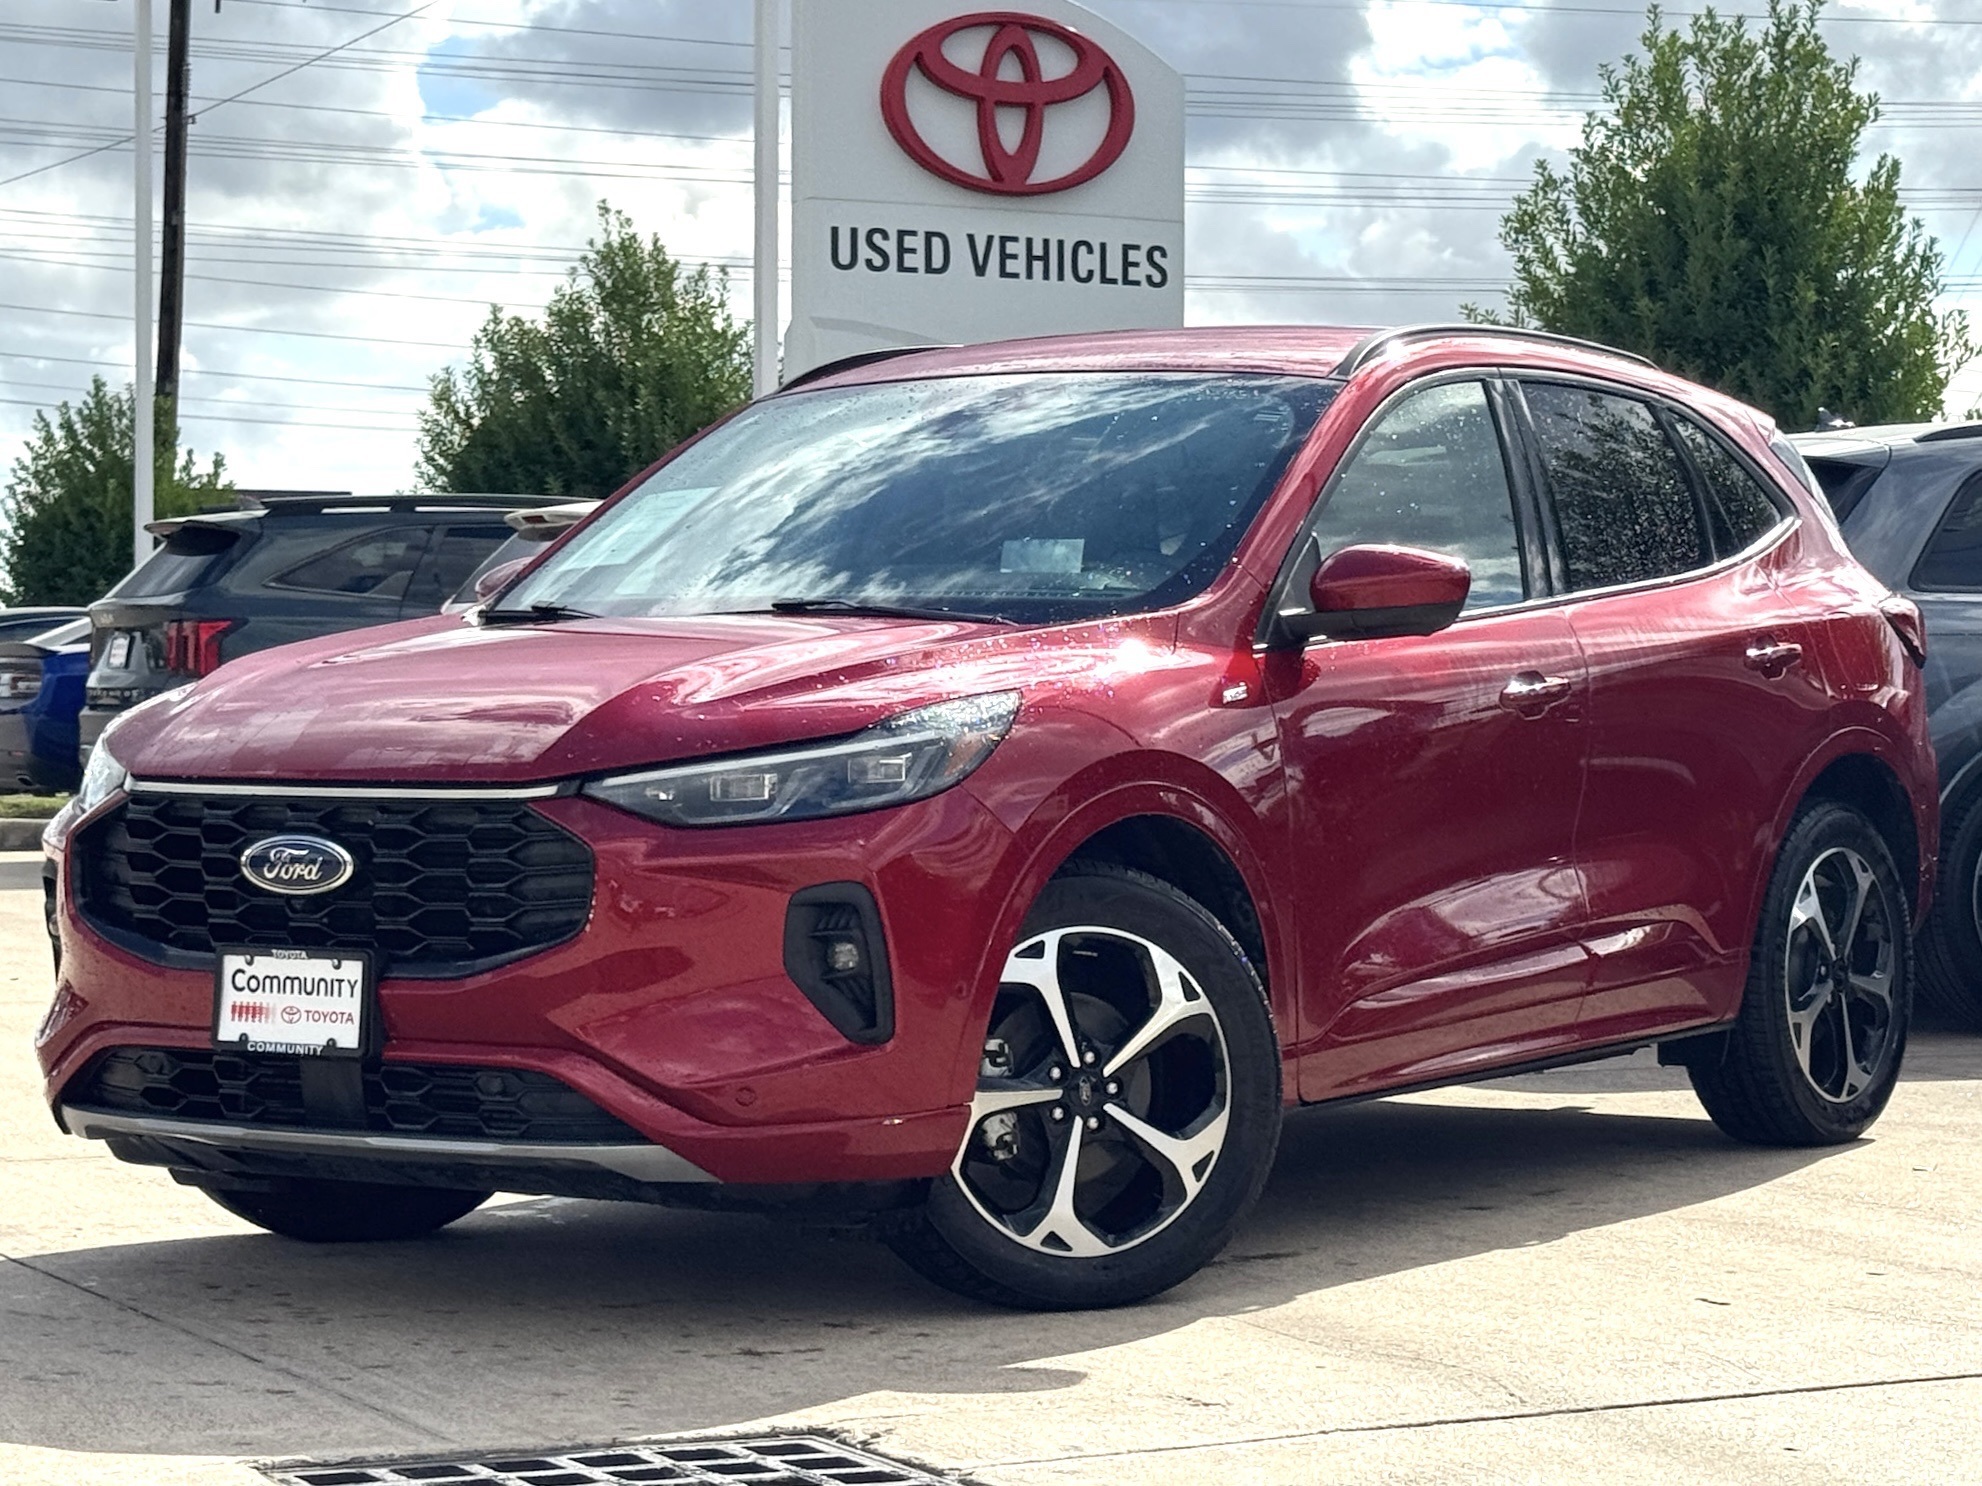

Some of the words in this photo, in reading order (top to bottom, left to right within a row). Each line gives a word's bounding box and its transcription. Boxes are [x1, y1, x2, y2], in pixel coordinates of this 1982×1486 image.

[829, 226, 951, 275] USED
[965, 233, 1169, 289] VEHICLES
[264, 846, 324, 880] Ford
[271, 949, 309, 959] TOYOTA
[304, 1009, 354, 1025] TOYOTA
[247, 1041, 323, 1055] COMMUNITY
